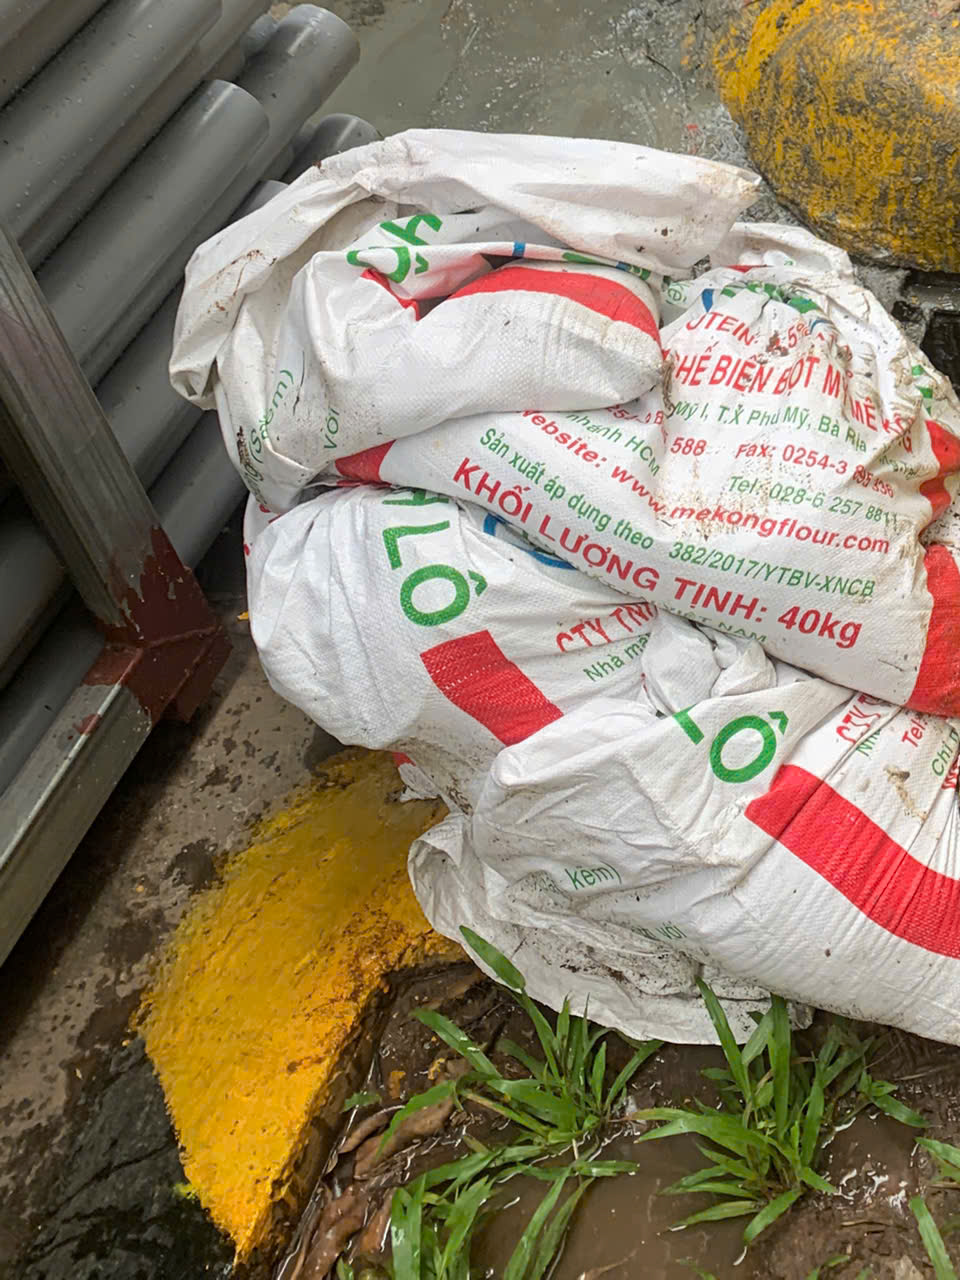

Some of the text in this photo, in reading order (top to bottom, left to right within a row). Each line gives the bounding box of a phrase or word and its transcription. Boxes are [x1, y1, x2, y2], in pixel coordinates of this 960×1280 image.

[670, 436, 707, 457] 588
[781, 443, 849, 475] 0254-3
[818, 413, 840, 438] Bà
[480, 427, 876, 598] Sản xuất áp dụng theo 382/2017/YTBV-XNCB
[610, 464, 890, 555] www.mekongflour.com
[623, 435, 661, 478] HCM
[768, 482, 826, 509] 028-6
[828, 495, 864, 517] 257
[452, 456, 864, 650] KHỐI LƯỢNG TỊNH: 40kg
